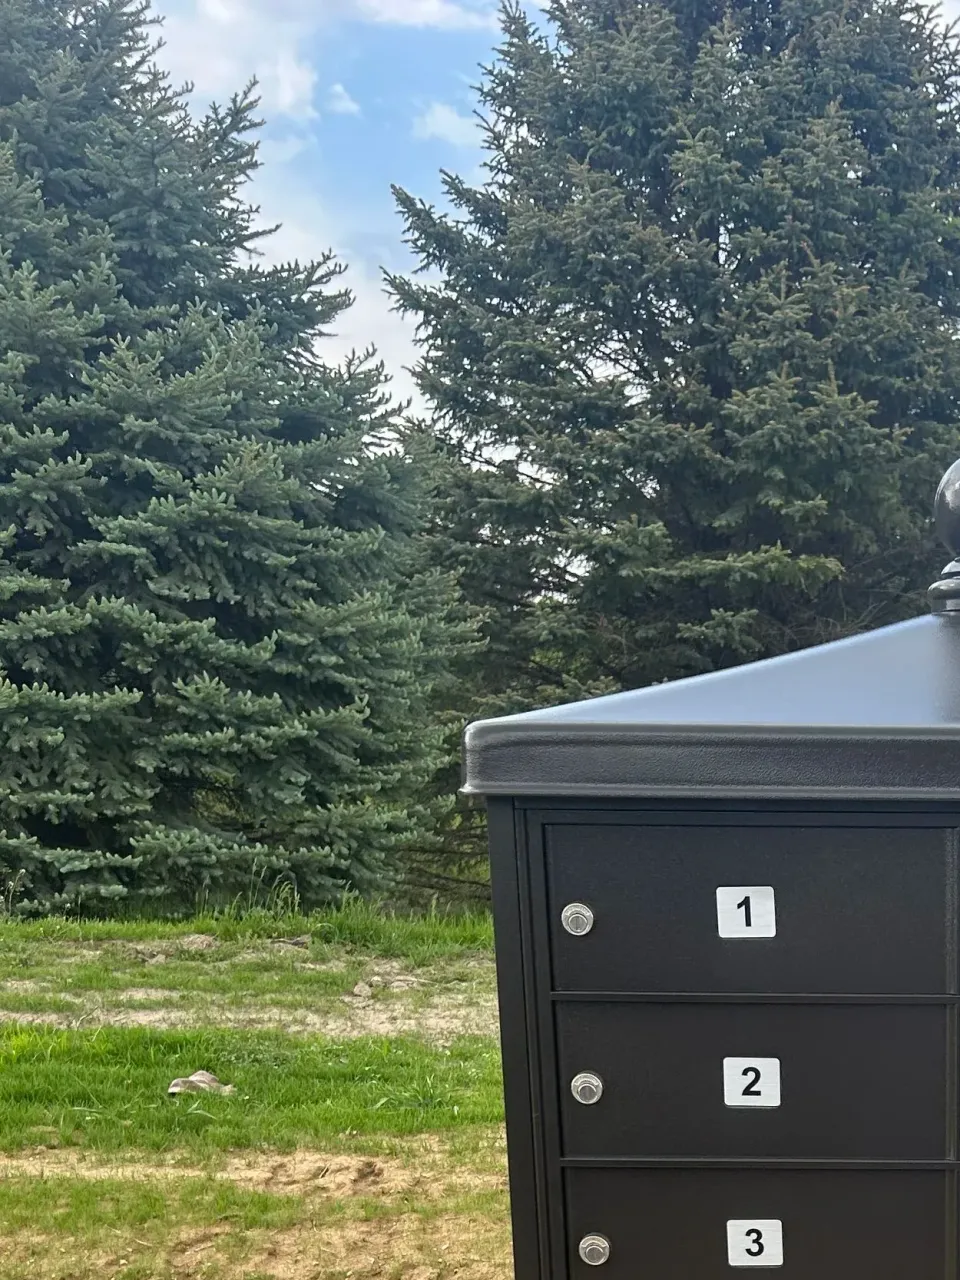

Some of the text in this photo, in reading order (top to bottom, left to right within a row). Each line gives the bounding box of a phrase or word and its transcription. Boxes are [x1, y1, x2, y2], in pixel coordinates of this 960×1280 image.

[737, 896, 751, 927] 1
[742, 1067, 761, 1096] 2
[746, 1229, 764, 1256] 3
